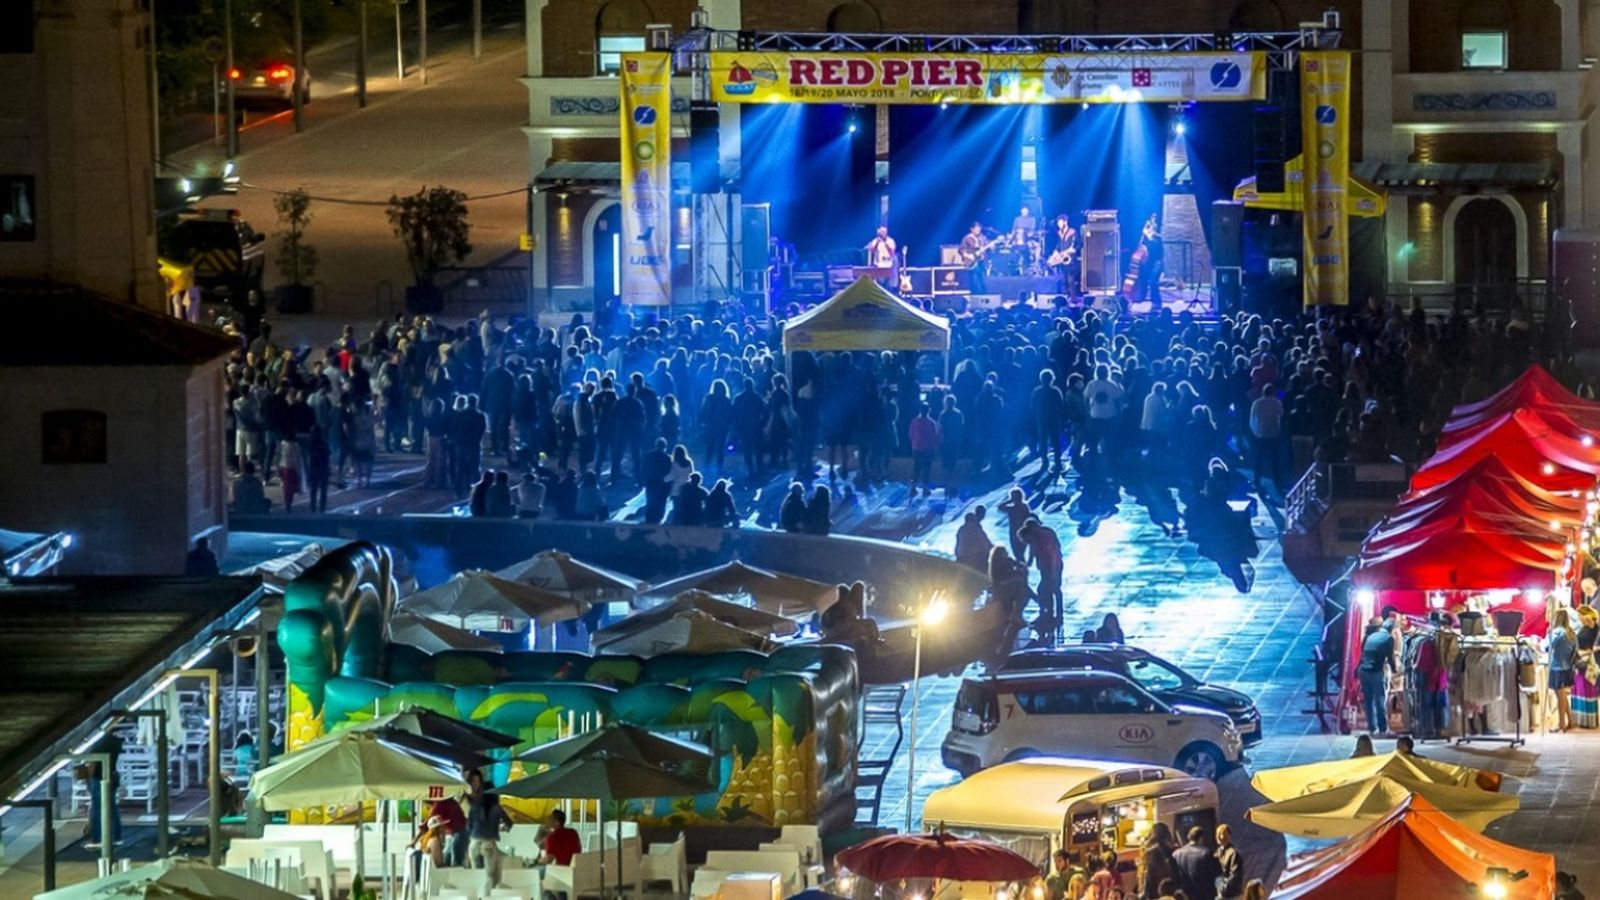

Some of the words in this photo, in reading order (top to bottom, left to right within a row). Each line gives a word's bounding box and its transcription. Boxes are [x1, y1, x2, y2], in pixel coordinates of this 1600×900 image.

[789, 60, 874, 84] RED
[882, 60, 983, 85] PIER
[836, 88, 868, 97] MAYO
[871, 88, 895, 97] 2018
[1004, 704, 1014, 719] 7
[1124, 728, 1149, 739] KIA
